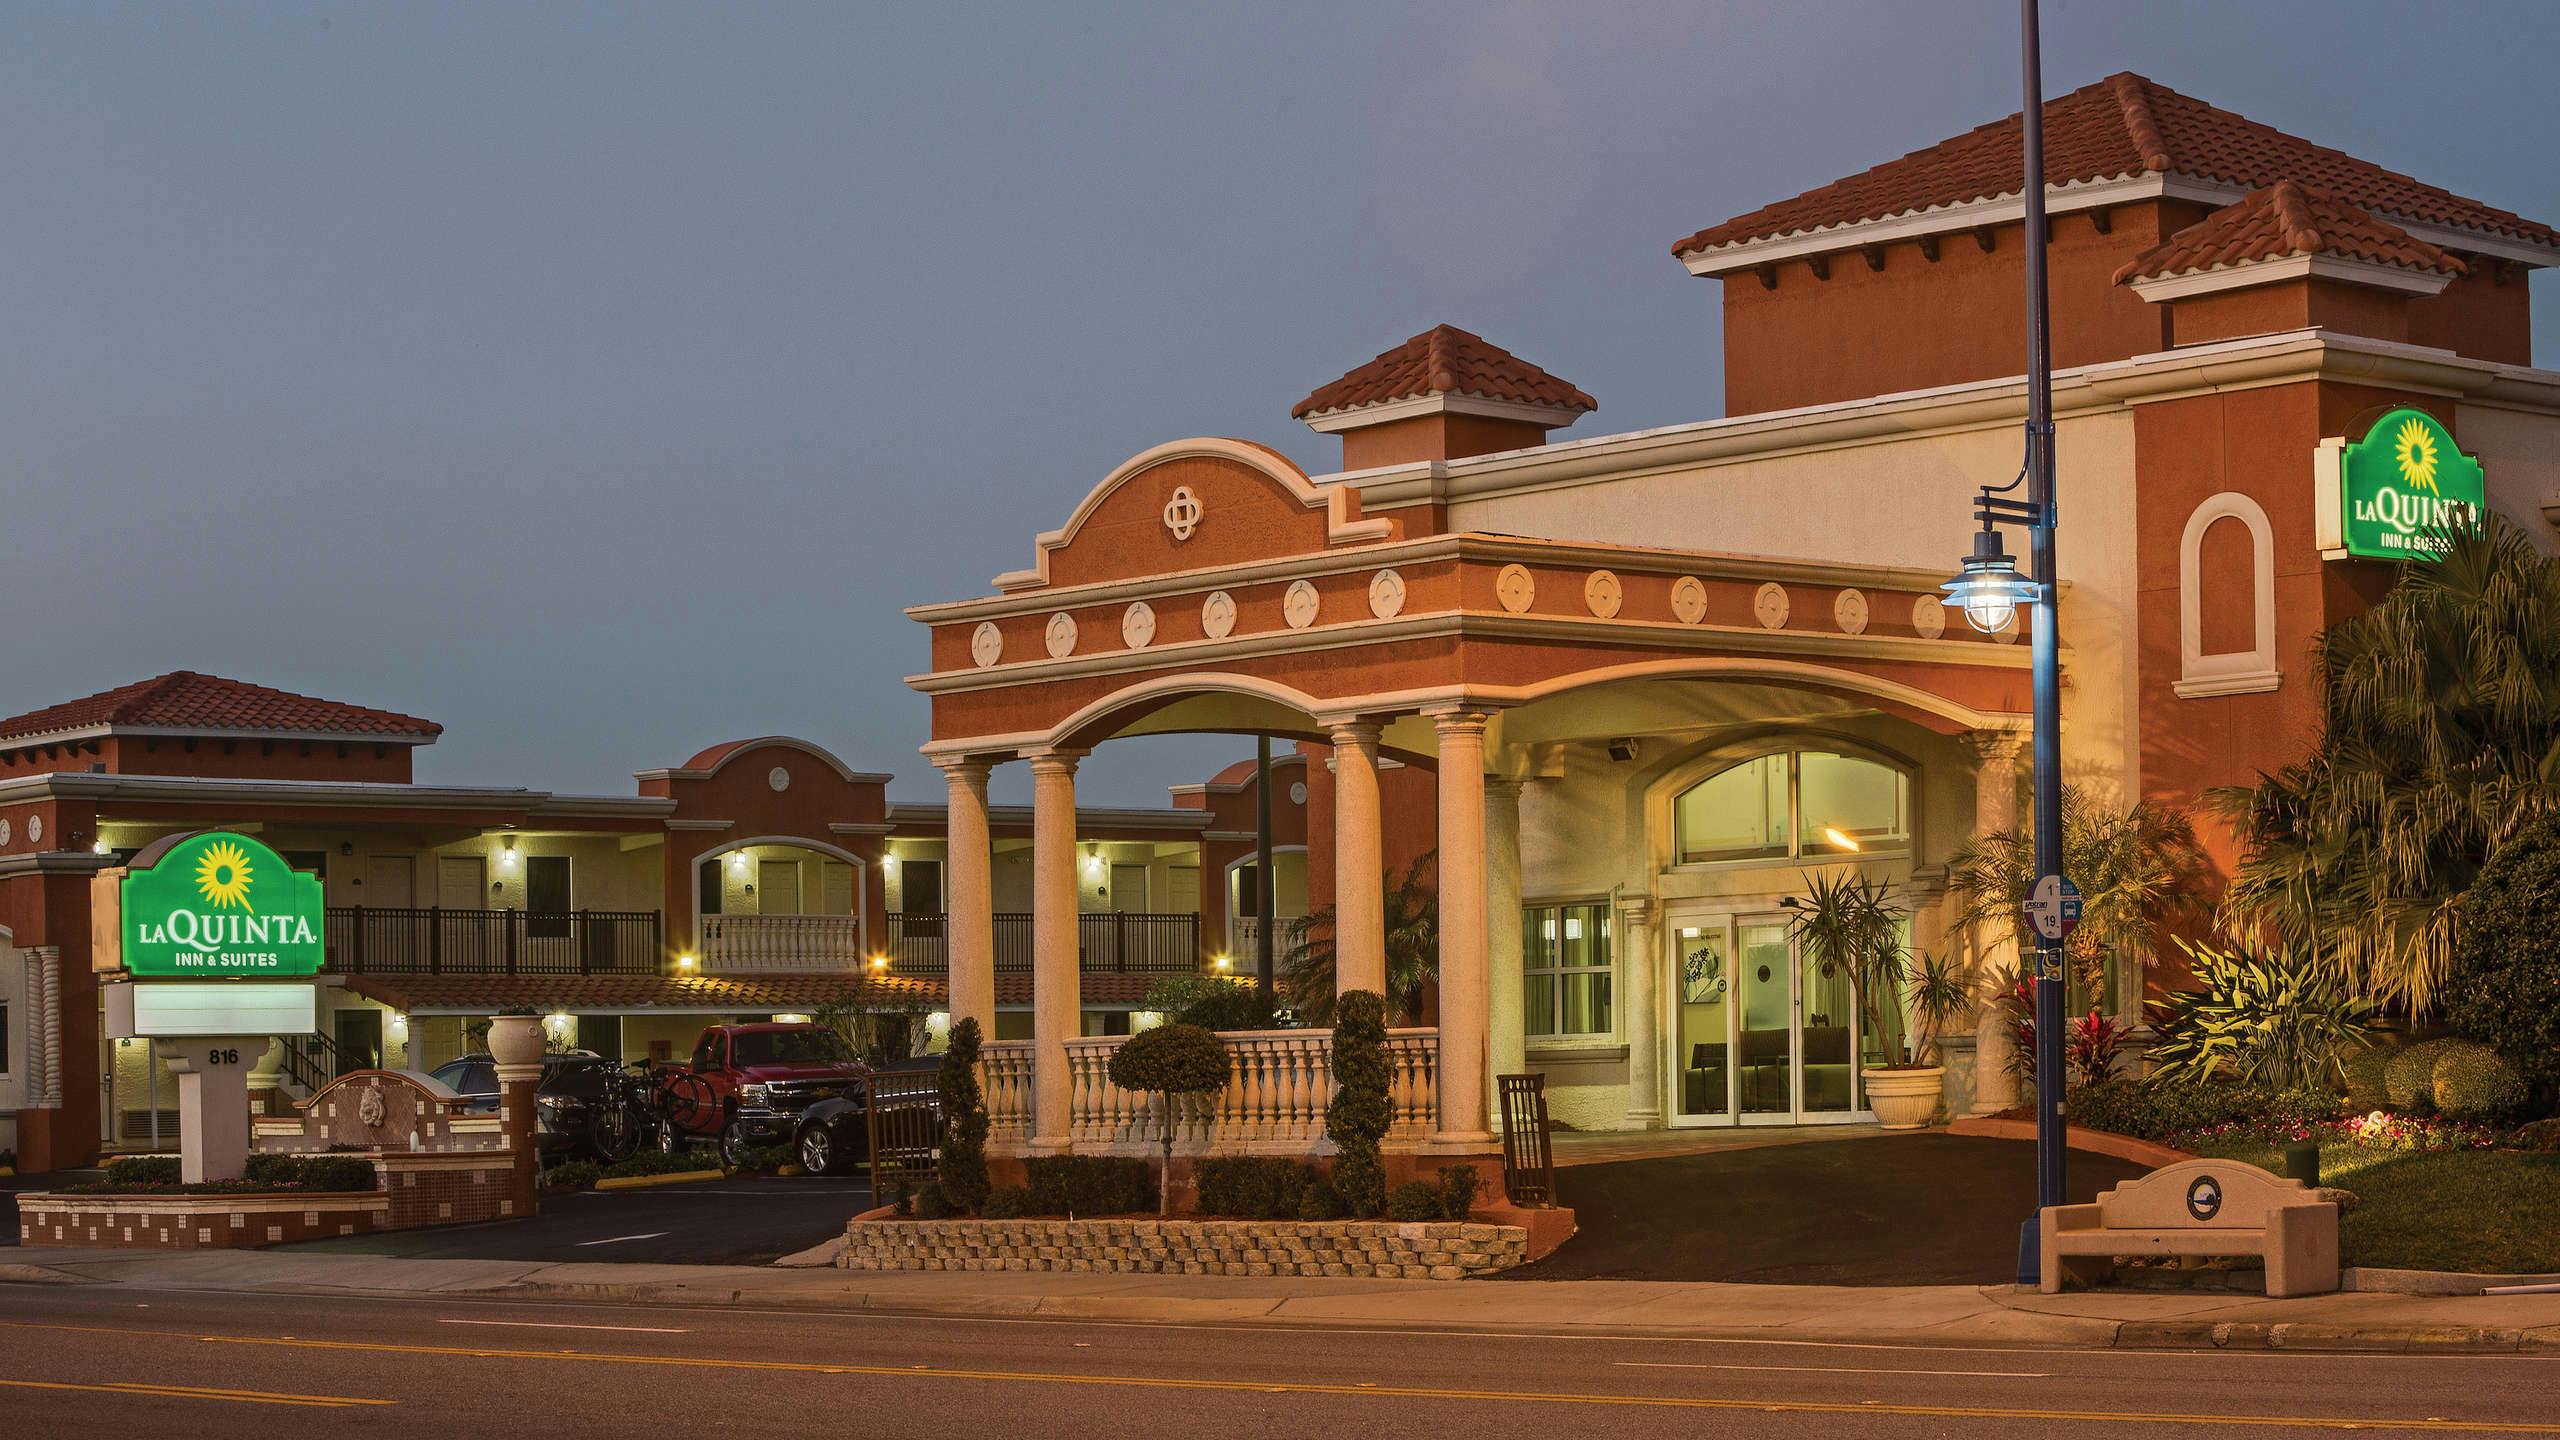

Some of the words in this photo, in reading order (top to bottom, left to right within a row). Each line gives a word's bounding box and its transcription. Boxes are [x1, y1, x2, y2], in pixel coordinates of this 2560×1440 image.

[2355, 500, 2377, 522] LA
[2381, 532, 2402, 549] INN
[2404, 536, 2411, 549] &
[2048, 884, 2053, 896] 1
[2044, 915, 2056, 927] 19
[139, 923, 168, 944] LA
[167, 908, 316, 952] QUINTA
[175, 952, 203, 967] INN
[207, 953, 217, 967] &
[220, 952, 278, 967] SUITES
[209, 1049, 239, 1065] 816
